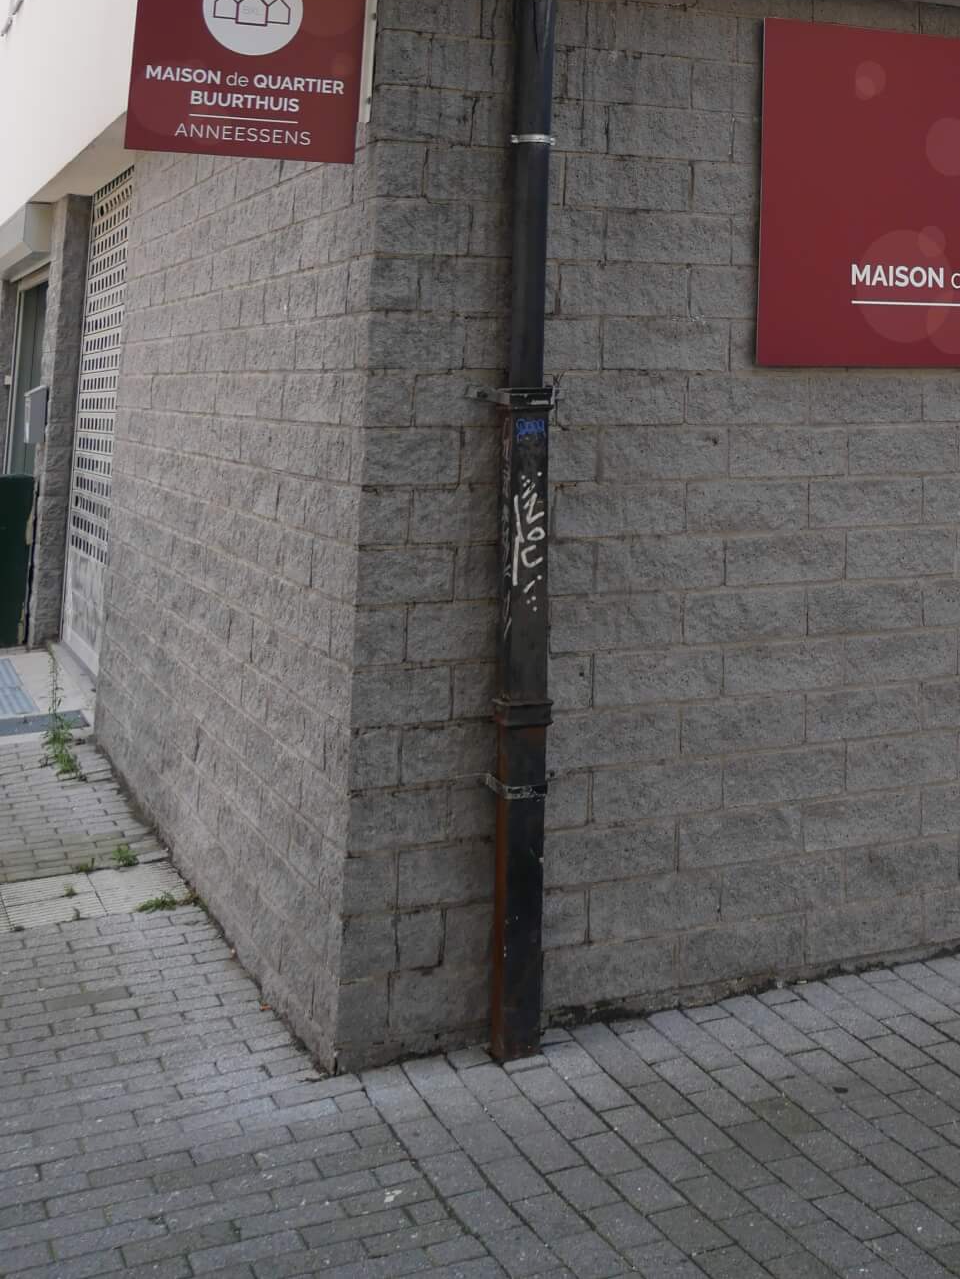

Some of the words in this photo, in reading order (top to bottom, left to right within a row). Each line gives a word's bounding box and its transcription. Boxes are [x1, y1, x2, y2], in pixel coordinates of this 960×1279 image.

[145, 65, 221, 85] MAISON
[226, 73, 249, 87] de
[253, 75, 345, 95] QUARTIER
[190, 91, 300, 112] BUURTHUIS
[174, 123, 311, 146] ANNEESSENS
[850, 264, 945, 288] MAISON
